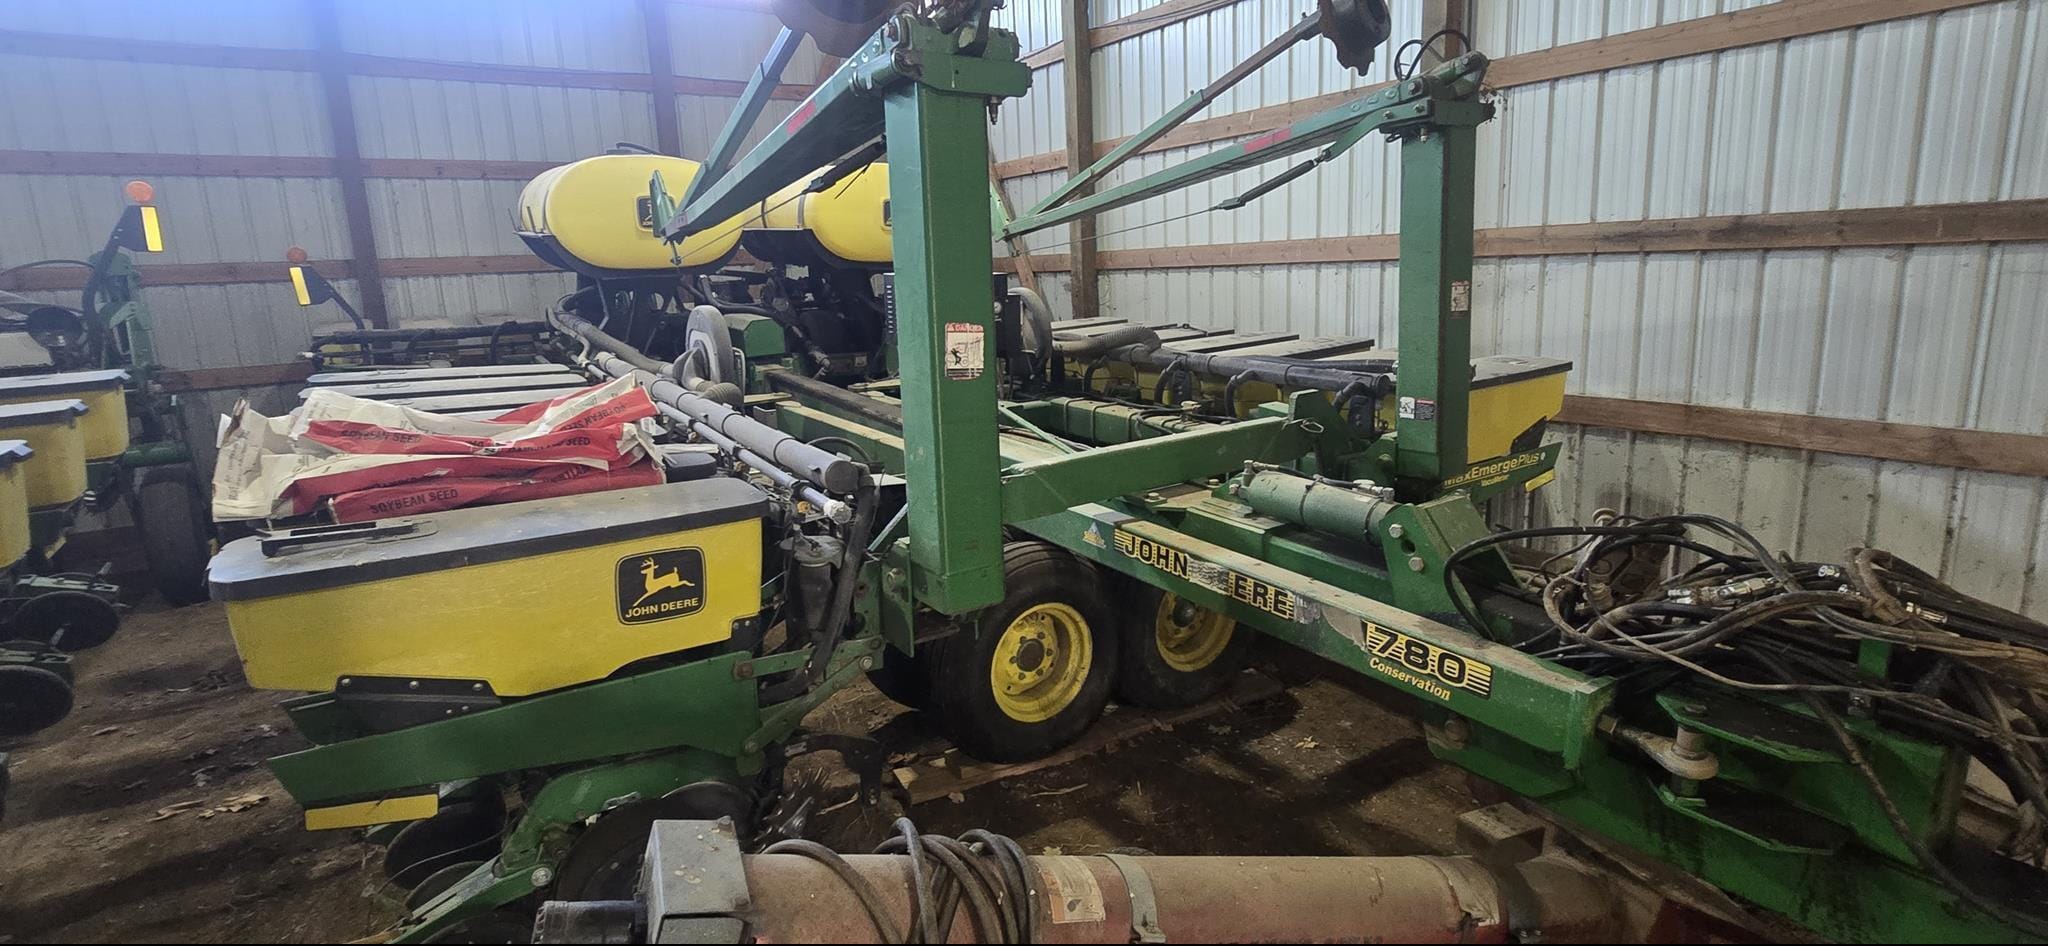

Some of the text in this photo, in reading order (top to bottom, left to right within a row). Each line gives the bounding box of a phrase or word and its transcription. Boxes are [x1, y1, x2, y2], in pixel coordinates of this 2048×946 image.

[565, 436, 591, 446] SEED
[369, 488, 459, 513] SOYBEAN SEED
[1124, 535, 1189, 578] JOHN
[625, 597, 700, 618] JOHN DEERE
[1373, 625, 1467, 685] 780
[1369, 656, 1452, 701] Conservation
